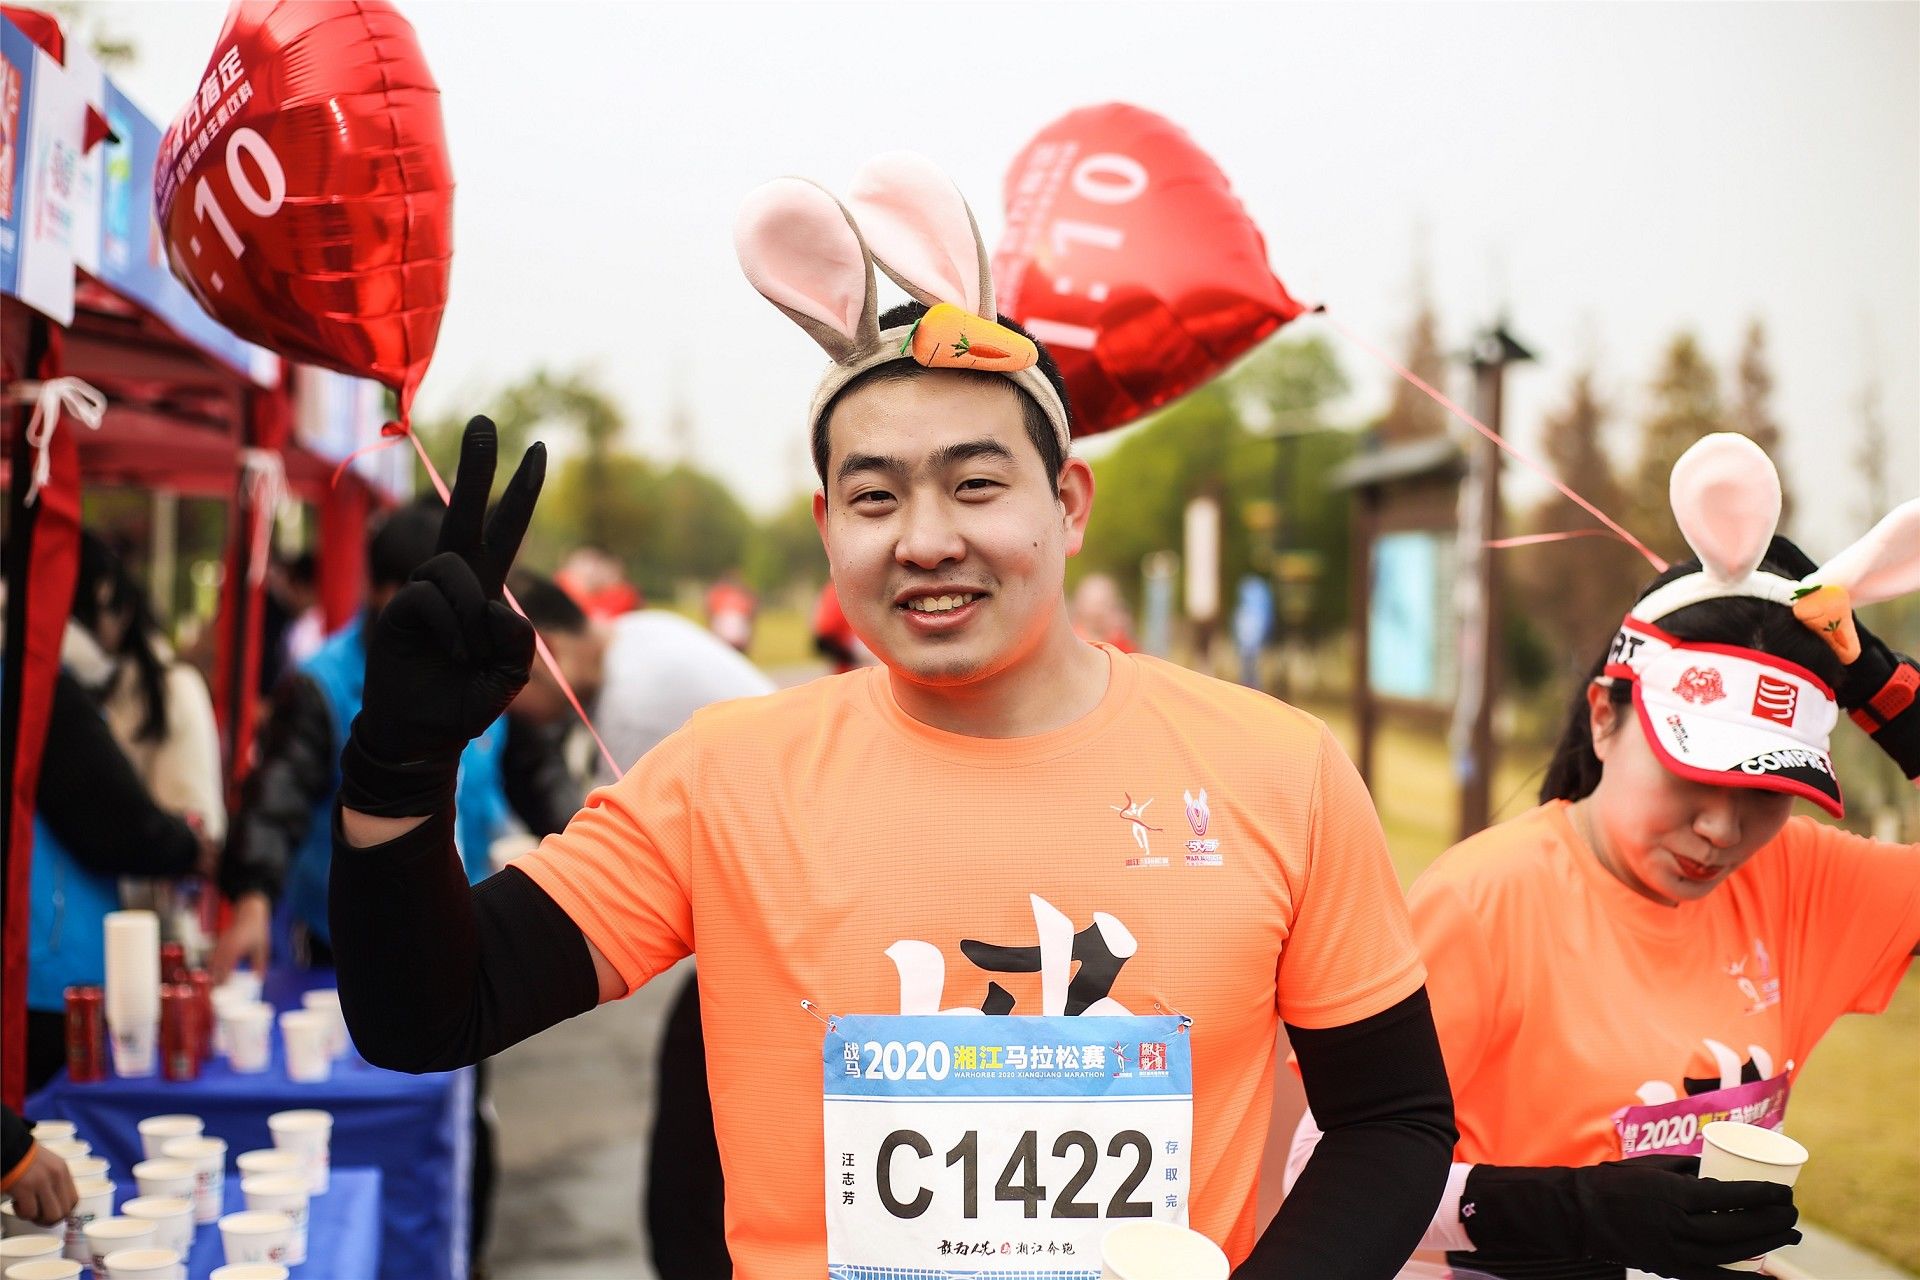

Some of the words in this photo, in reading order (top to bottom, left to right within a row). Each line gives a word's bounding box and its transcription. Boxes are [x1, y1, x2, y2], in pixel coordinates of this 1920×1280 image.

[843, 1042, 861, 1078] 战马
[864, 1040, 951, 1081] 2020
[953, 1044, 1106, 1071] 湘江马拉松赛
[1636, 1113, 1698, 1152] 2020
[842, 1152, 855, 1205] 汪志芳
[876, 1129, 1153, 1219] C1422
[1165, 1141, 1179, 1208] 存取完
[937, 1239, 996, 1257] 敢为人先
[1016, 1240, 1076, 1256] 湘江奔跑
